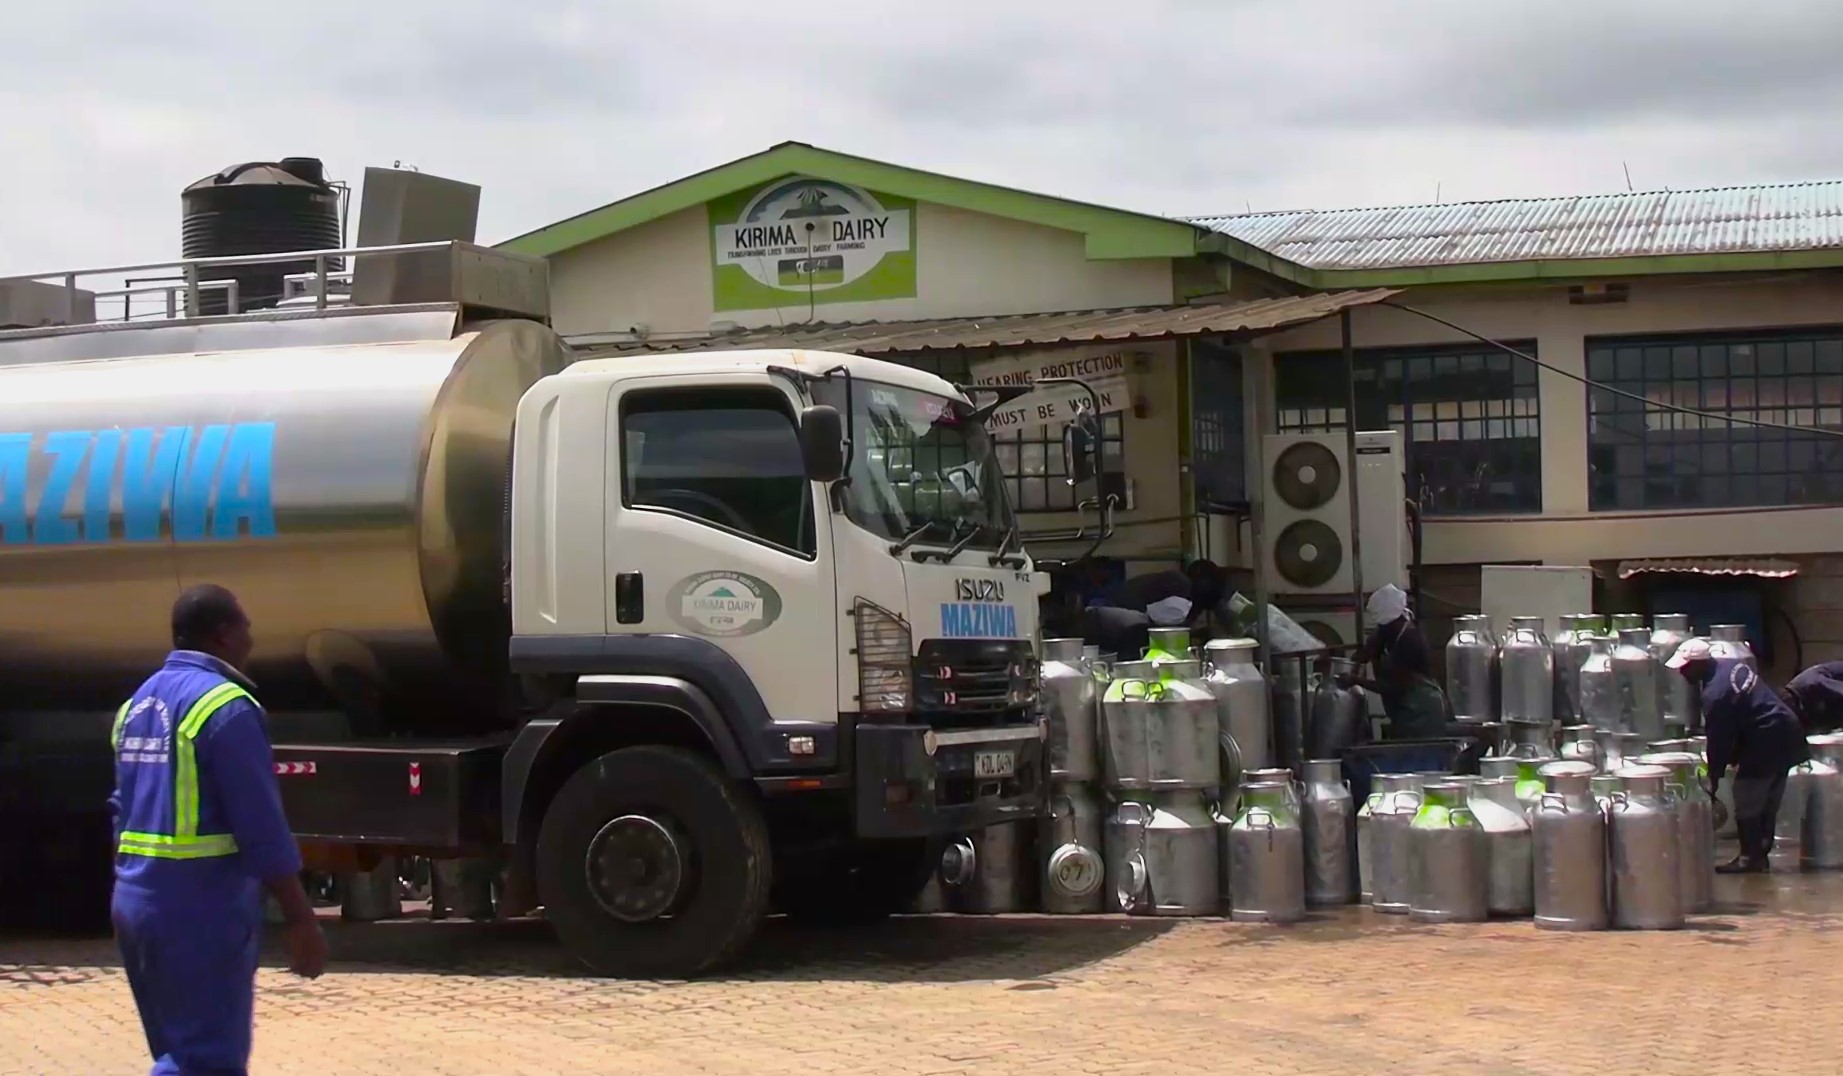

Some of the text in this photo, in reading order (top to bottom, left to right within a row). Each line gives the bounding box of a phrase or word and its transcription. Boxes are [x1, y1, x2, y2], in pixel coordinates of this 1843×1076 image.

[735, 217, 889, 248] KIRIMA DAIRY
[813, 244, 831, 253] DAIRY
[1041, 352, 1123, 378] PROTECTION
[989, 393, 1112, 428] MUST BE WON
[955, 578, 1004, 602] ISUZU
[728, 600, 756, 612] DAIRY
[940, 603, 1017, 637] MAZIWA
